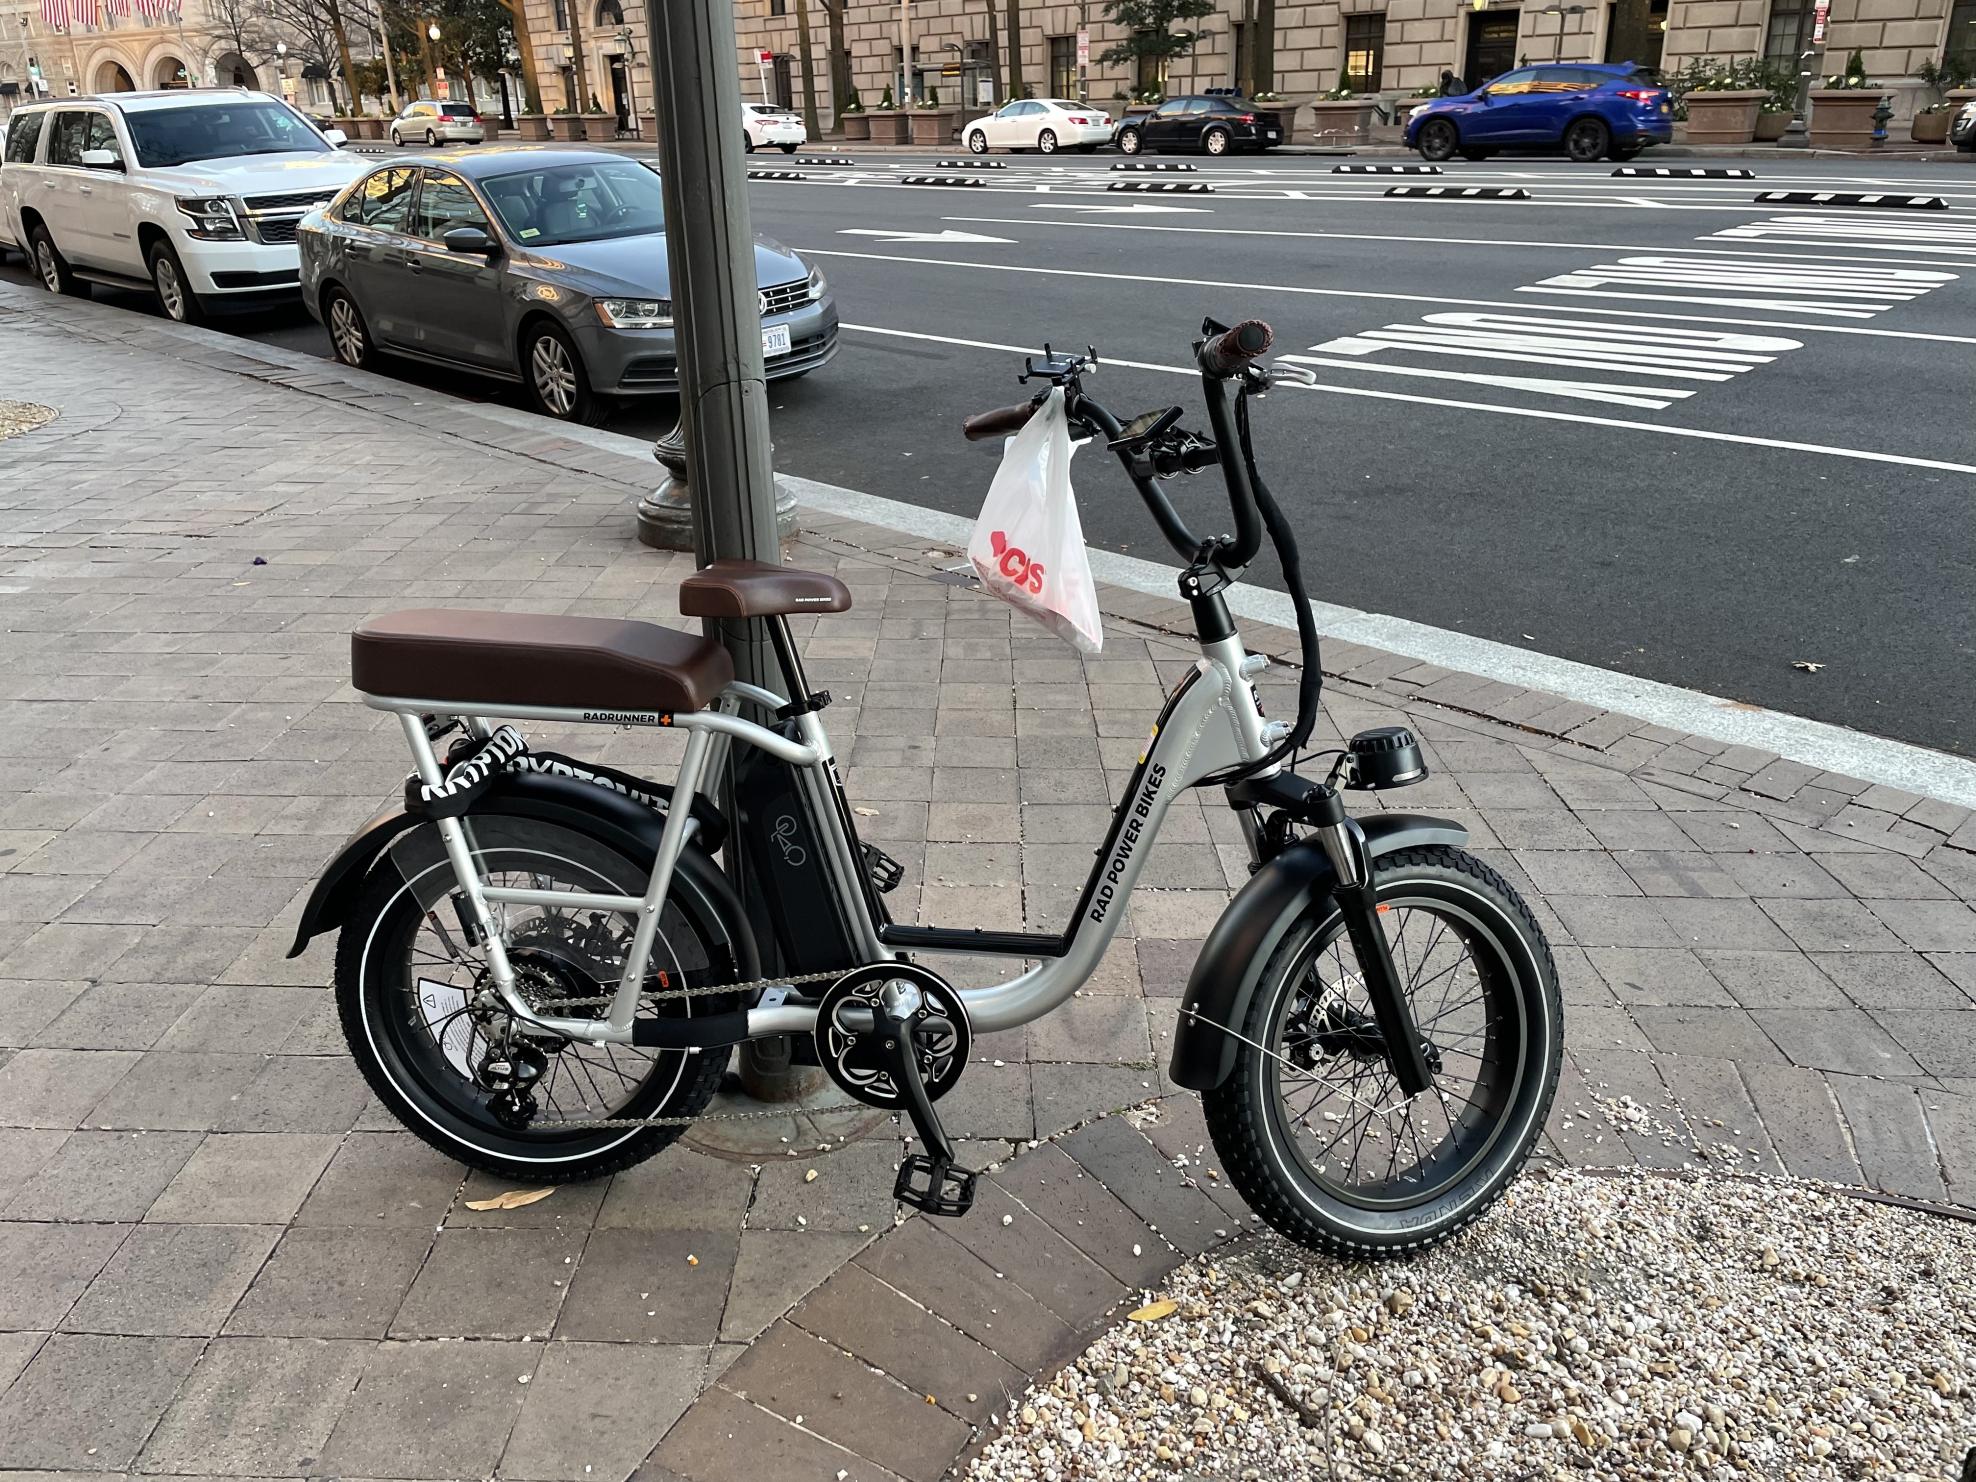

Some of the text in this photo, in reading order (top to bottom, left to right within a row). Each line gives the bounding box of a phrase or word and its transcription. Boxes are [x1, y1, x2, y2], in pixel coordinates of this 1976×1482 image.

[1514, 256, 1960, 318] ONLY
[767, 333, 786, 348] 9781
[1272, 312, 1805, 409] ONLY
[583, 712, 656, 723] RADRUNNER
[1090, 884, 1114, 923] RAD
[1107, 818, 1144, 885] POWER
[1135, 762, 1166, 819] BIKES
